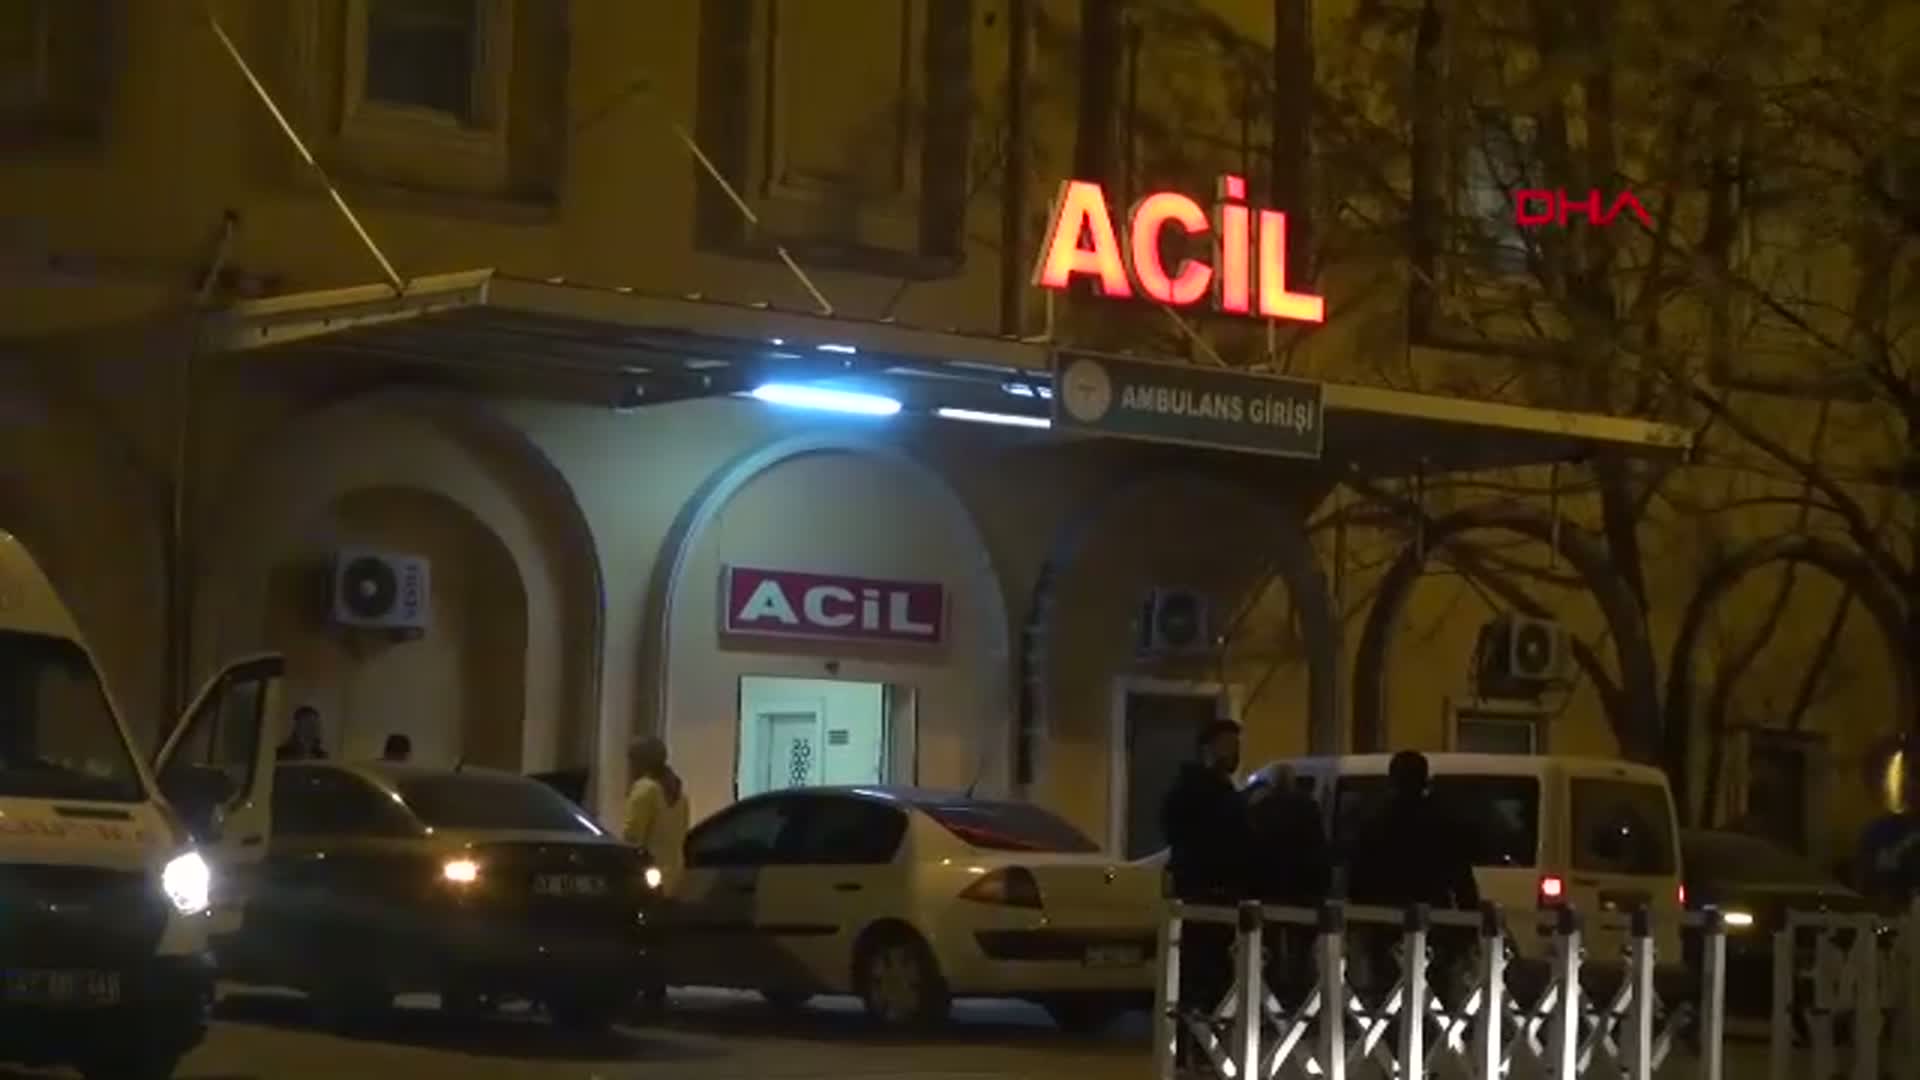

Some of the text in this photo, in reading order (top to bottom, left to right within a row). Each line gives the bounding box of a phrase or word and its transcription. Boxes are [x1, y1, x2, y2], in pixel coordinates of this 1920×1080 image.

[1038, 174, 1326, 323] ACİL
[1120, 384, 1315, 436] AMBULANS GİRİŞİ
